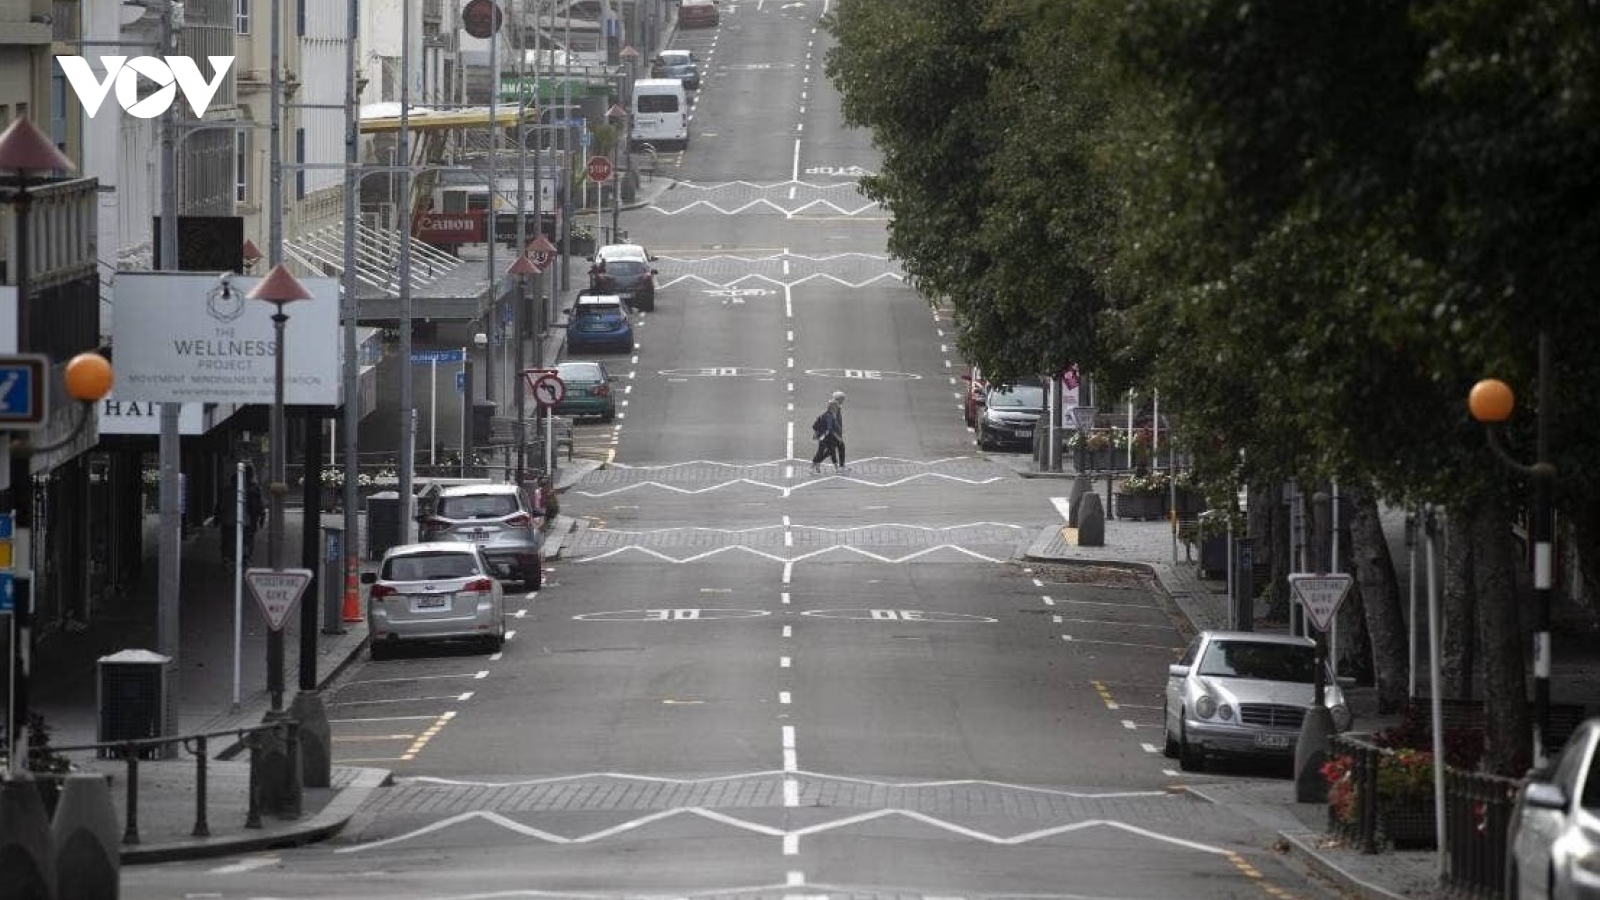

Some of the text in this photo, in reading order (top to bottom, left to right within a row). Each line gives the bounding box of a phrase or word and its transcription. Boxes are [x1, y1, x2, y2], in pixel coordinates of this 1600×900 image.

[418, 217, 474, 231] Canon
[215, 328, 236, 338] THE
[174, 340, 277, 357] WELLNESS
[198, 360, 253, 371] PROJECT
[128, 374, 186, 384] MOVEMENT
[266, 590, 289, 600] GIVE
